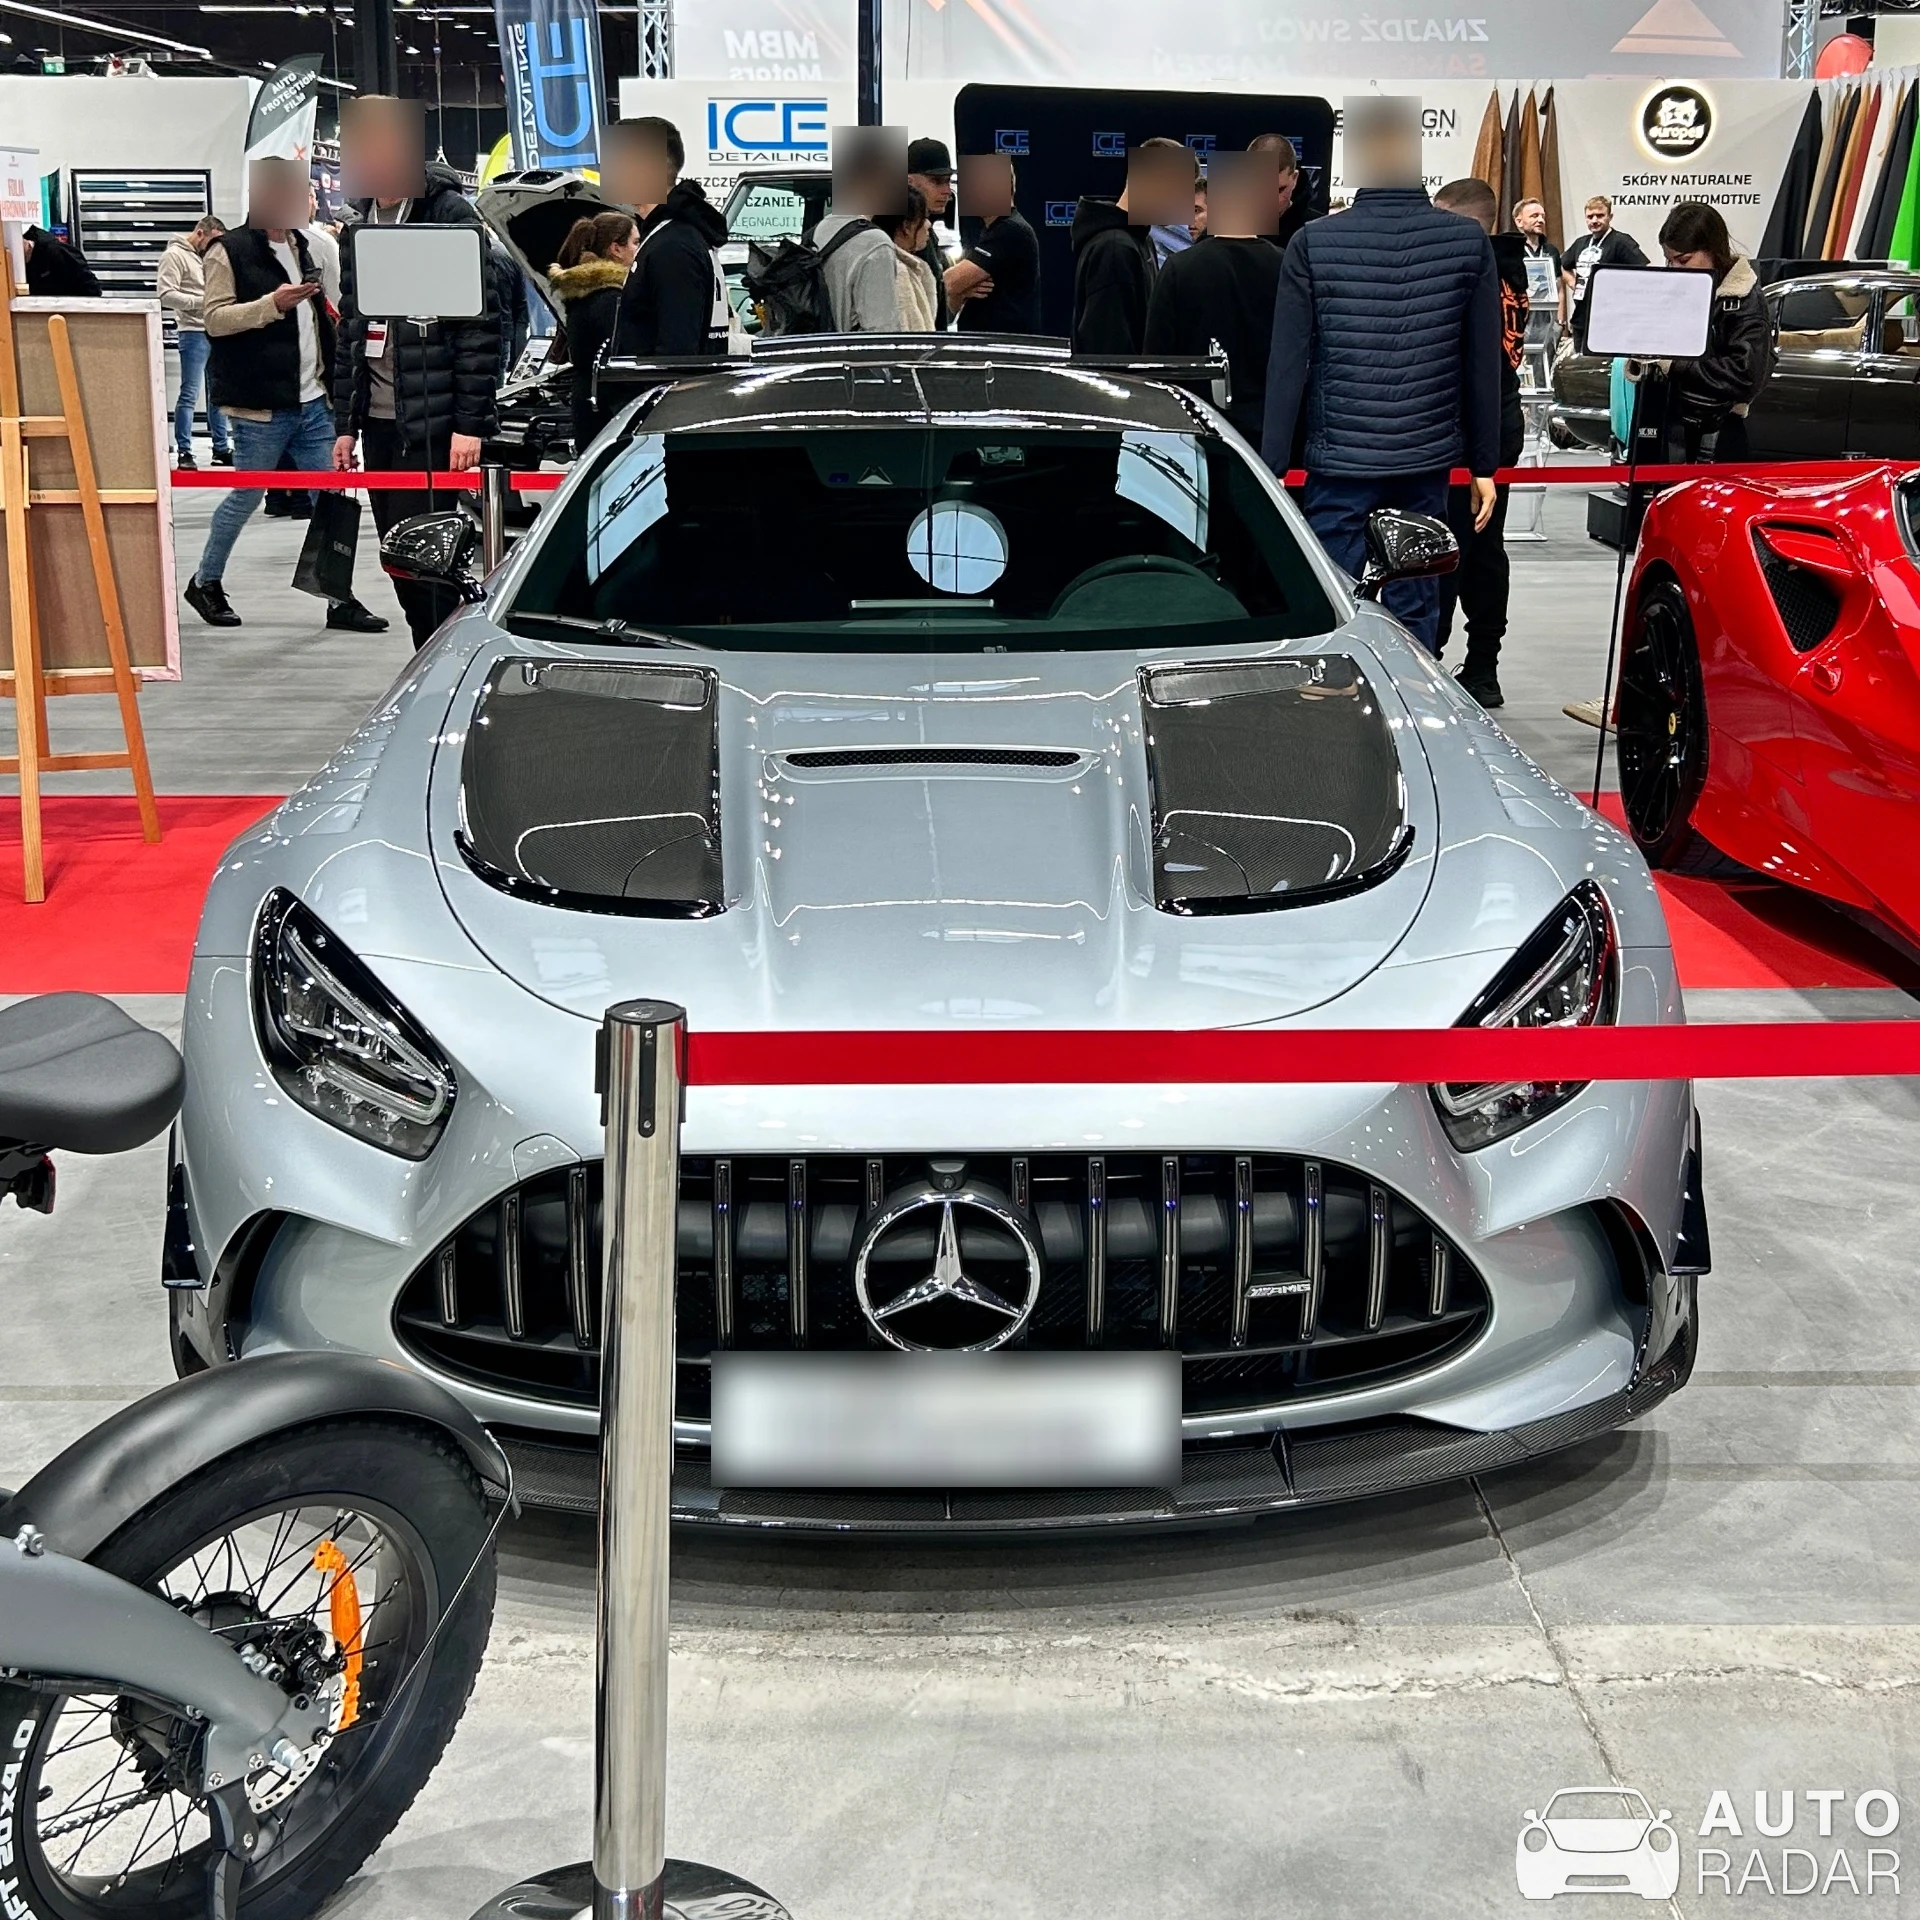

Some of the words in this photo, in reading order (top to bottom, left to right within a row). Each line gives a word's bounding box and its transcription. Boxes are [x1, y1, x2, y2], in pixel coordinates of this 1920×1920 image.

[260, 70, 317, 116] PROTECTION
[272, 72, 297, 94] AUTO
[283, 92, 306, 113] FILM
[708, 103, 828, 150] ICE
[709, 152, 828, 162] DETAILING
[1622, 172, 1667, 186] SKÓRY
[1671, 174, 1752, 185] NATURALNE
[1611, 194, 1670, 206] TKANINY
[1673, 194, 1761, 205] AUTOMOTIVE
